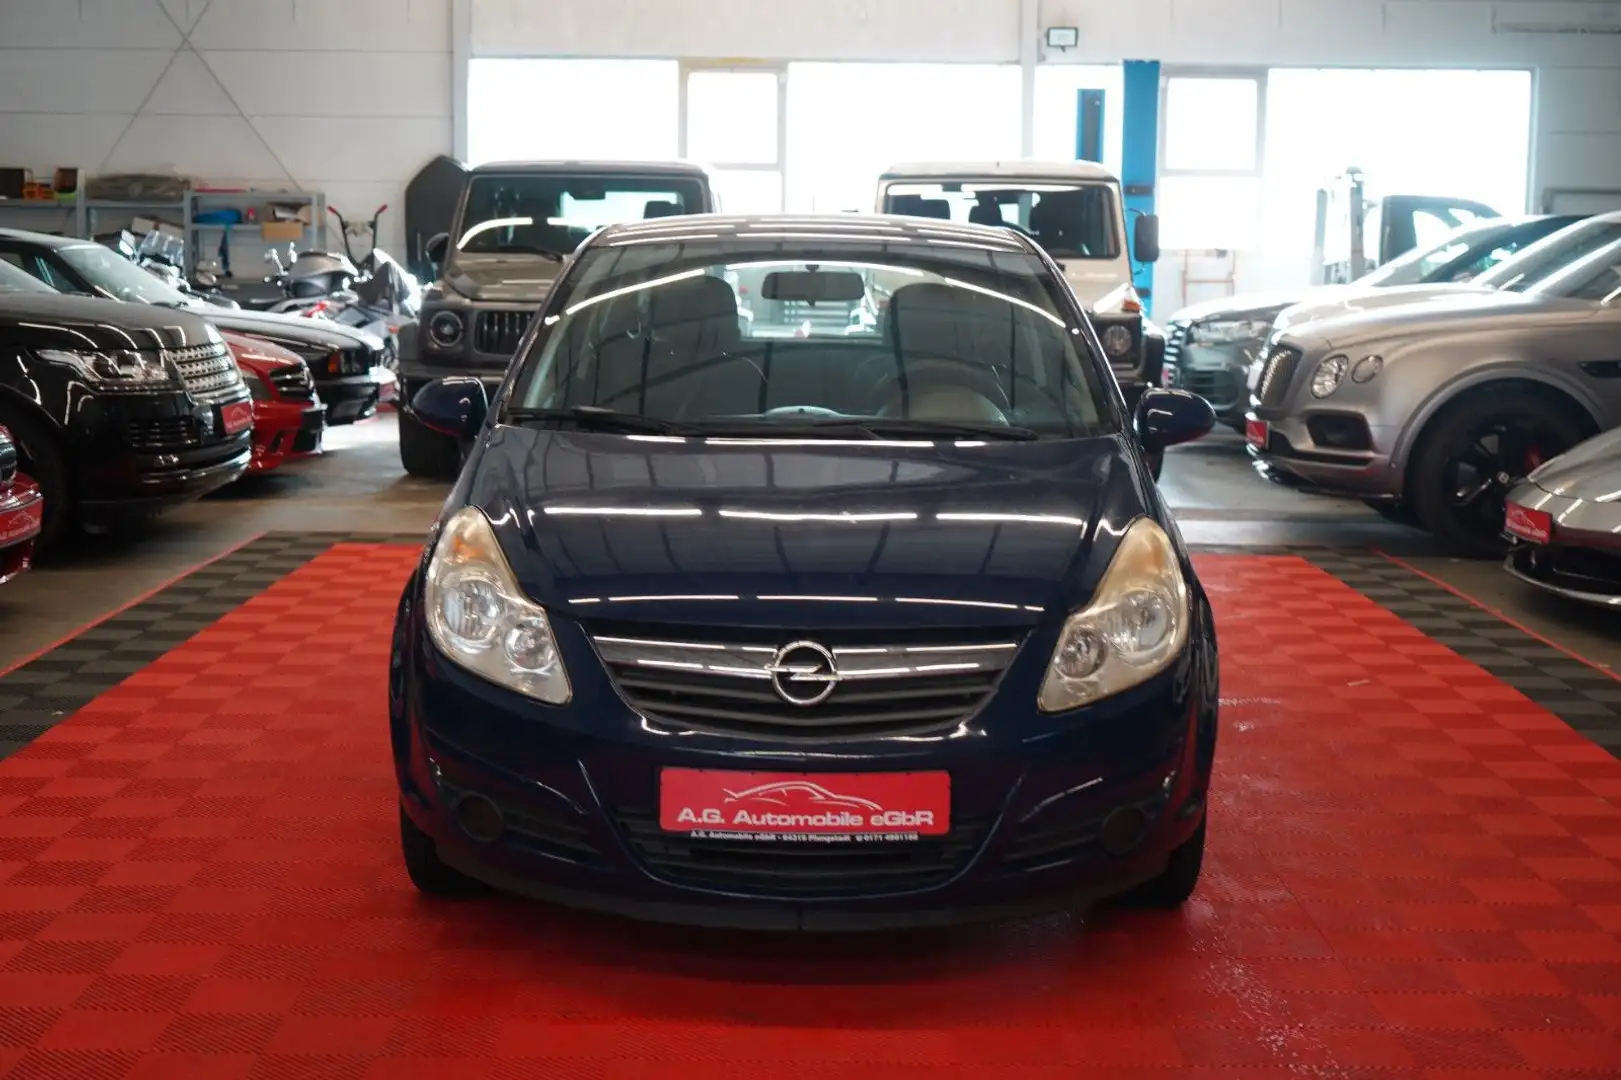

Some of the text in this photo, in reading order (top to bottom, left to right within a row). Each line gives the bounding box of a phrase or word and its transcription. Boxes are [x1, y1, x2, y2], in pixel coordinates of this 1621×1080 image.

[677, 807, 934, 826] A.G. Automobile eGbR
[709, 831, 753, 840] Automobile
